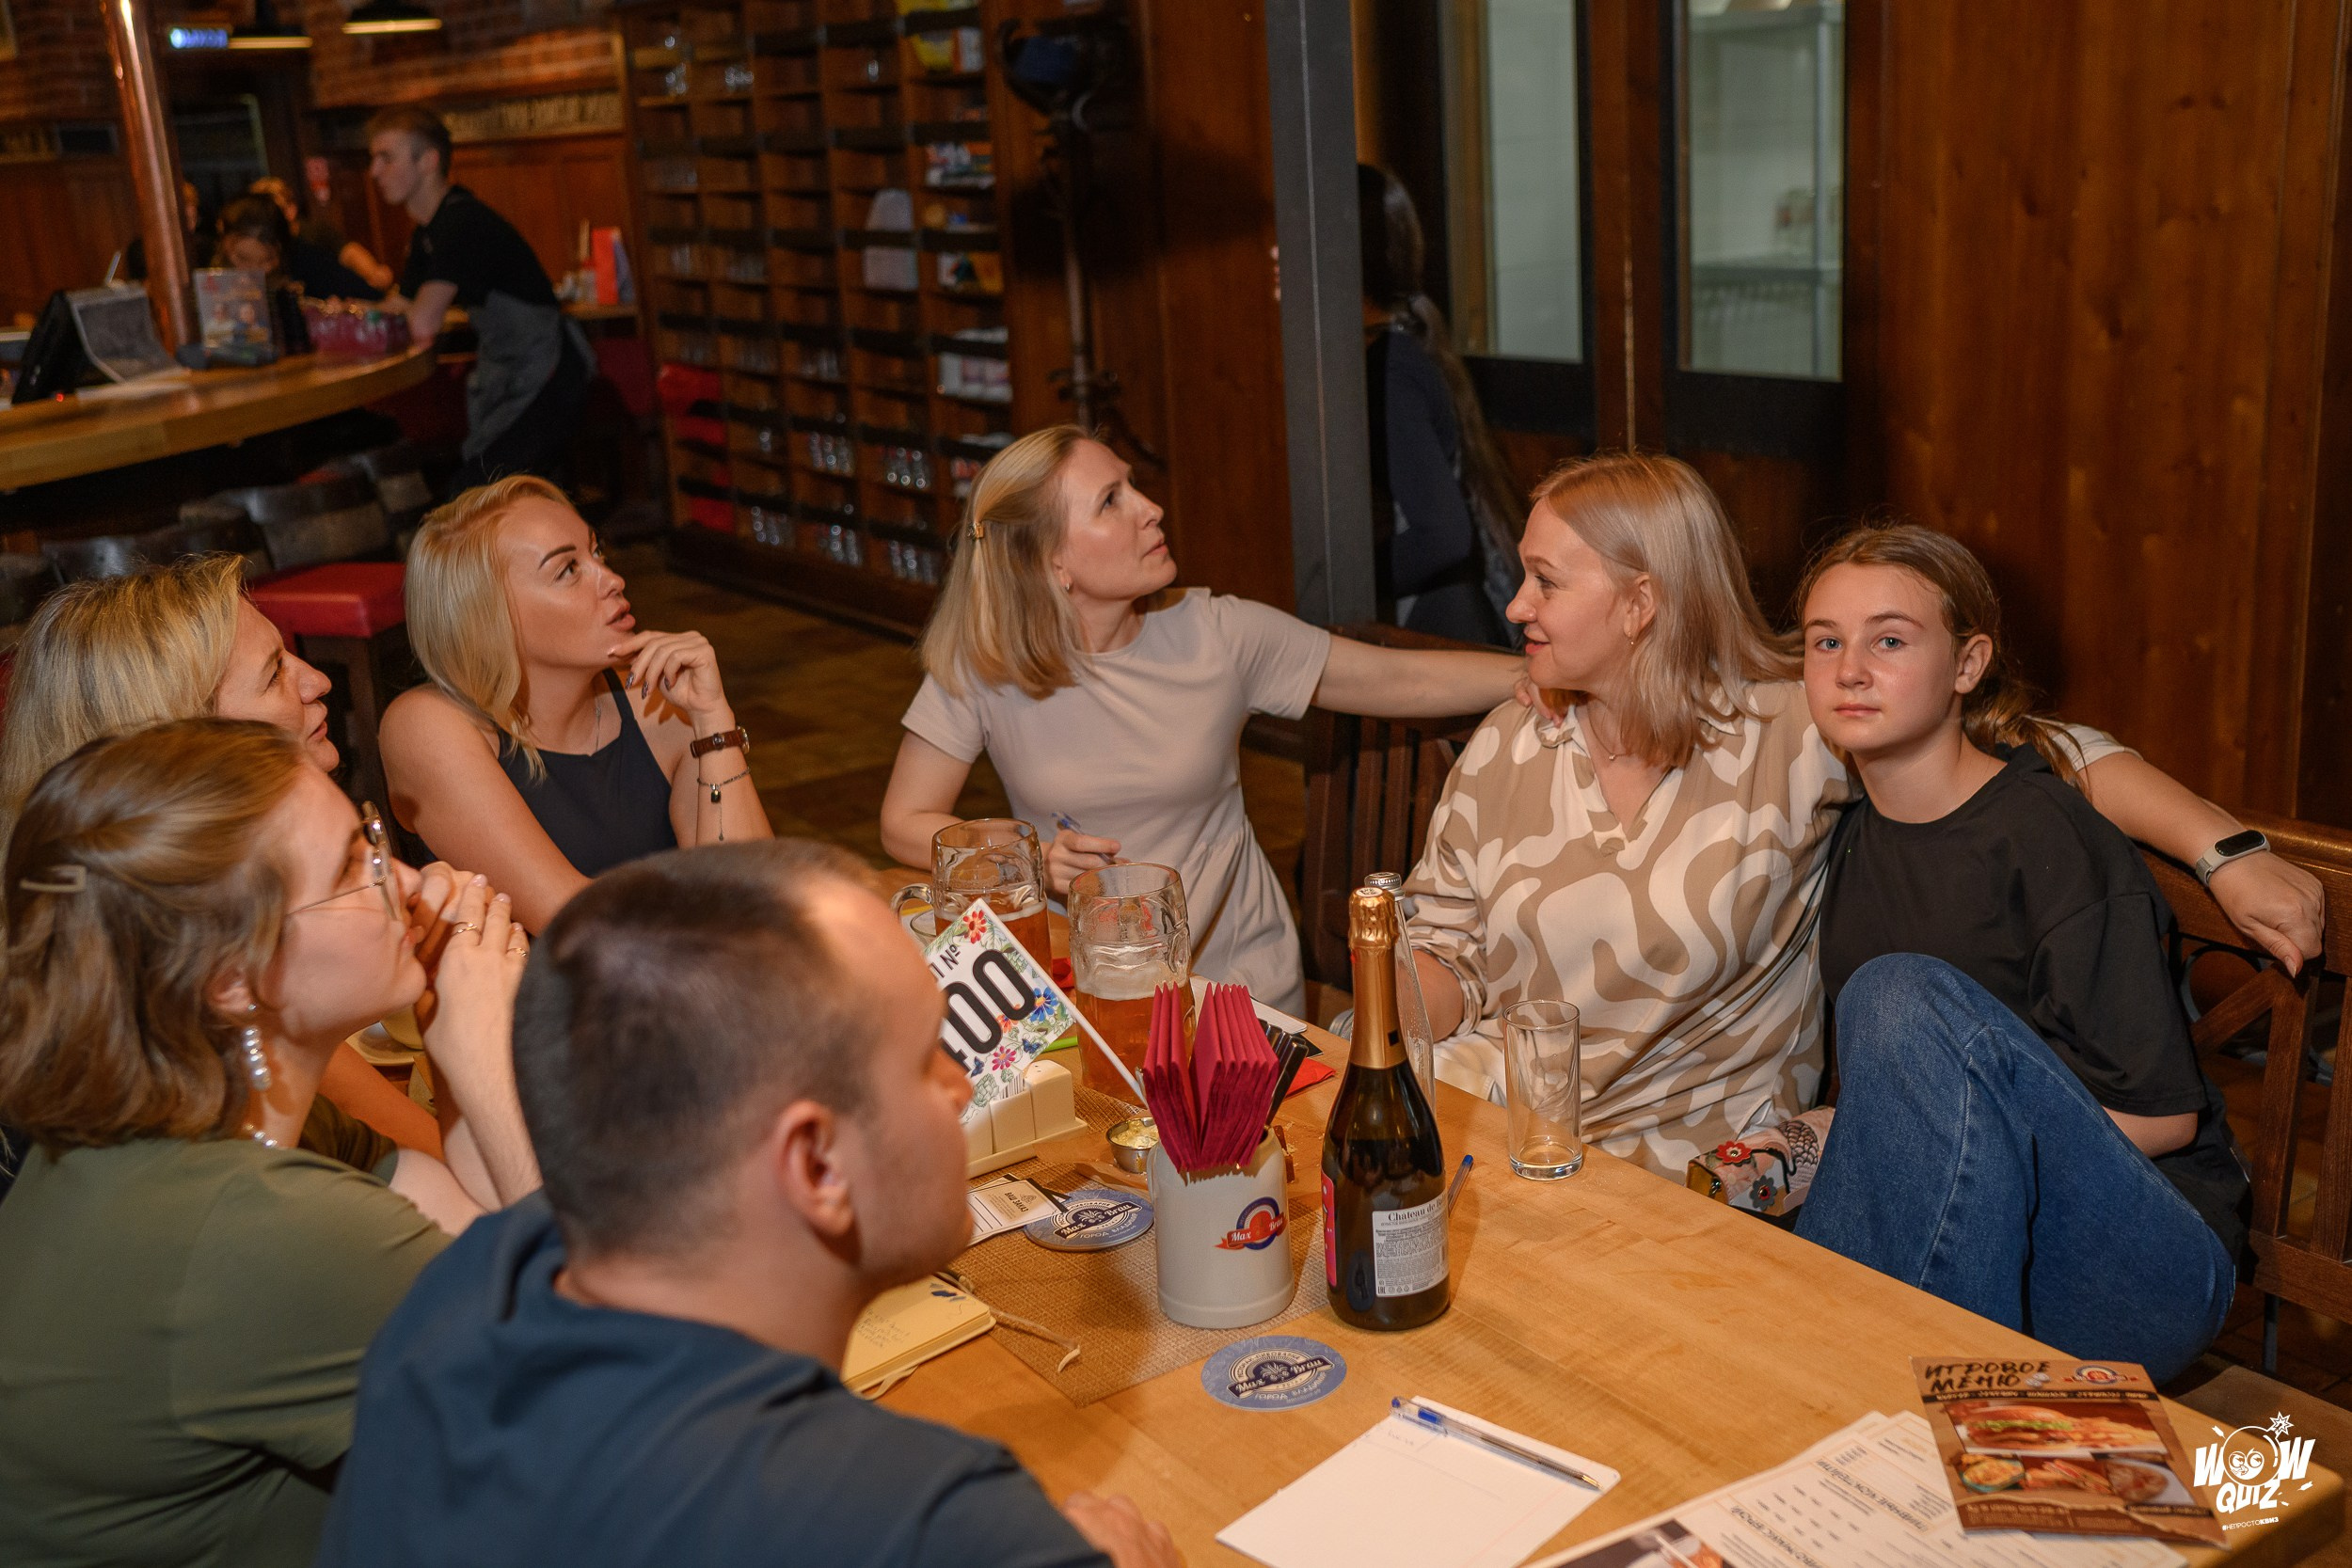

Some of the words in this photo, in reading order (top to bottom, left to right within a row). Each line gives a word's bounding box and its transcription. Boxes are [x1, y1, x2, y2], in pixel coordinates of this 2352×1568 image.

[1060, 1222, 1088, 1236] Max
[1232, 1230, 1252, 1242] Max
[1924, 1360, 2051, 1380] ИГРОВОЕ
[1235, 1378, 1266, 1394] Max
[1930, 1372, 2022, 1393] МЕНЮ
